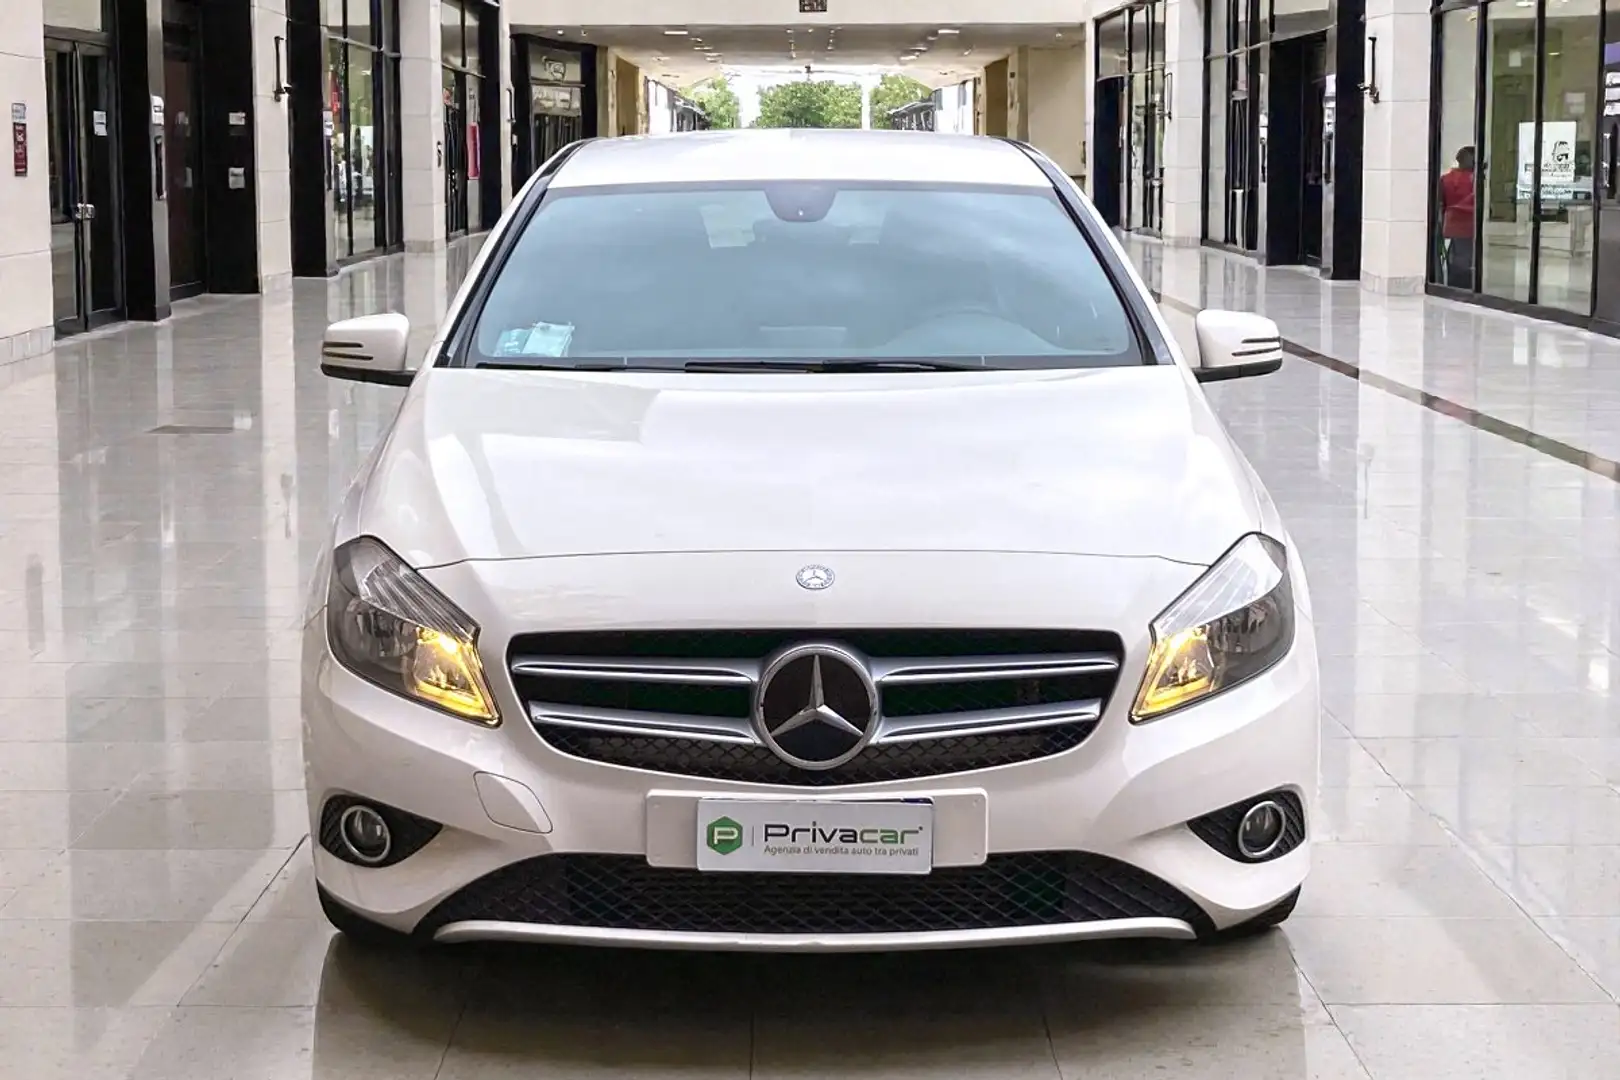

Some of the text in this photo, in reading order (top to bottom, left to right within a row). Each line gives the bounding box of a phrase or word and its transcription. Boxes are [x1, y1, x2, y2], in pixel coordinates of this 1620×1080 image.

[713, 826, 738, 845] P
[764, 821, 919, 844] Privacar
[764, 844, 918, 857] Agenzia di vendita auto tra privati
